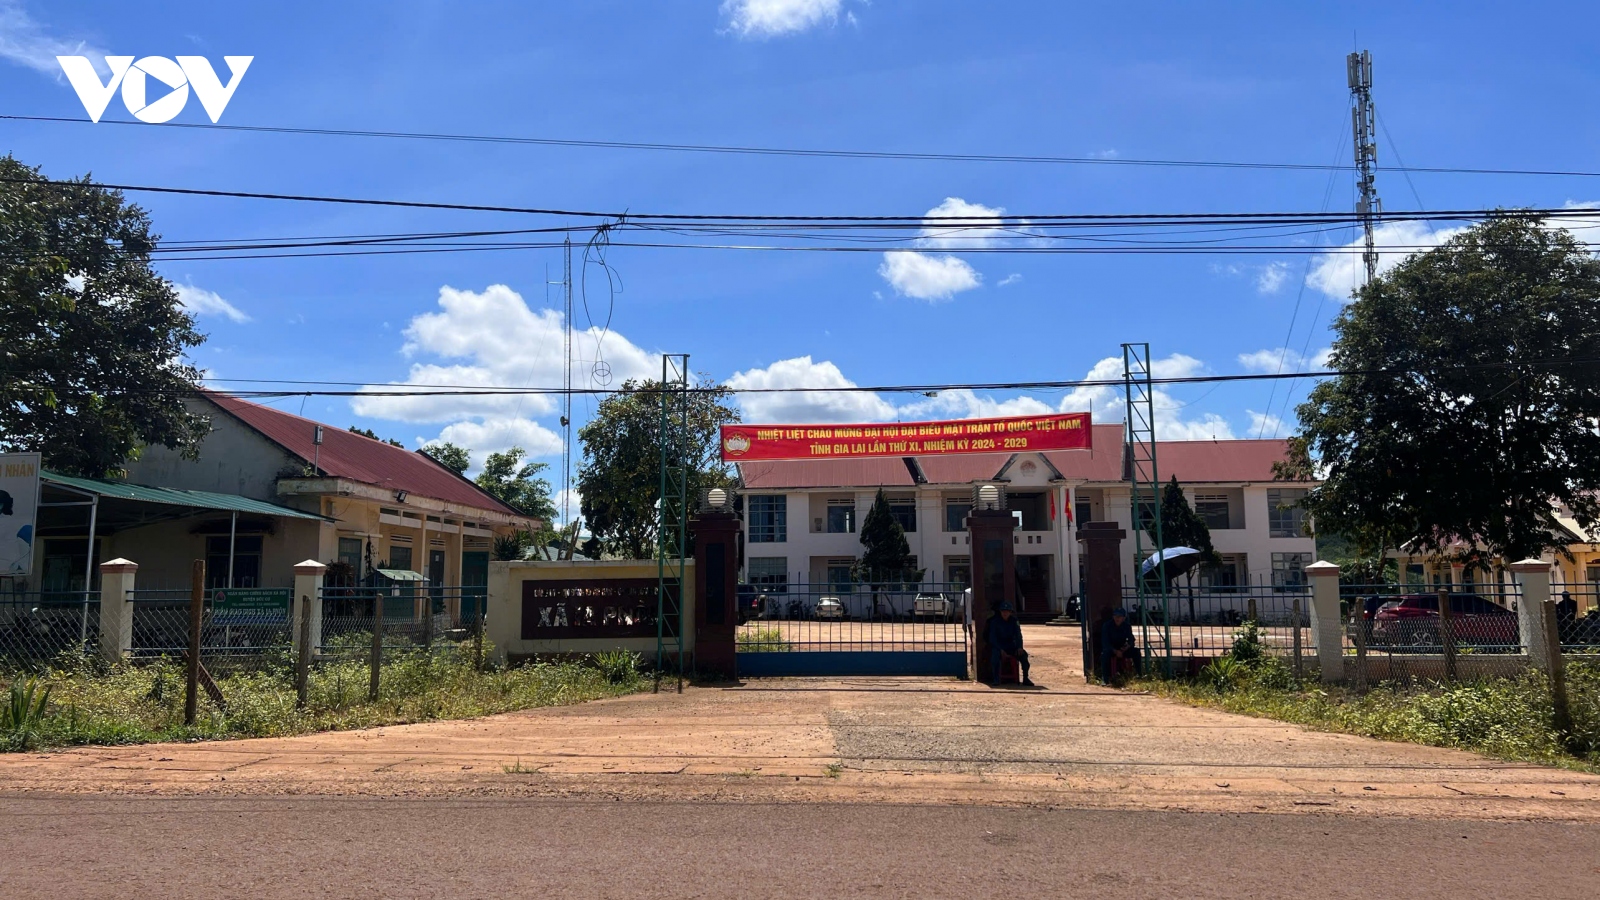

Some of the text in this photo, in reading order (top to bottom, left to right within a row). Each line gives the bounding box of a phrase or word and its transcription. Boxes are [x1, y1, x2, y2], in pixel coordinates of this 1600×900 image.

[758, 429, 783, 441] NHIỆT
[786, 429, 804, 441] LIỆT
[808, 427, 831, 438] CHÀO
[865, 427, 880, 438] ĐẠI
[883, 427, 898, 438] HỘI
[901, 426, 916, 437] ĐẠI
[920, 422, 940, 435] BIỂU
[967, 422, 991, 435] TRẬN
[1008, 420, 1033, 432] QUỐC
[1036, 419, 1055, 432] VIỆT
[1059, 419, 1081, 429] NAM
[810, 442, 830, 454] TỈNH
[834, 444, 849, 453] GIA
[852, 443, 865, 453] LAI
[869, 440, 886, 453] LẦN
[889, 441, 907, 452] THỨ
[909, 443, 921, 452] XI,
[924, 439, 954, 452] NHIỆM
[957, 438, 968, 450] KỲ
[972, 439, 995, 449] 2024
[1004, 438, 1027, 448] 2029
[5, 460, 34, 478] NHÂN
[537, 602, 568, 627] XÃ
